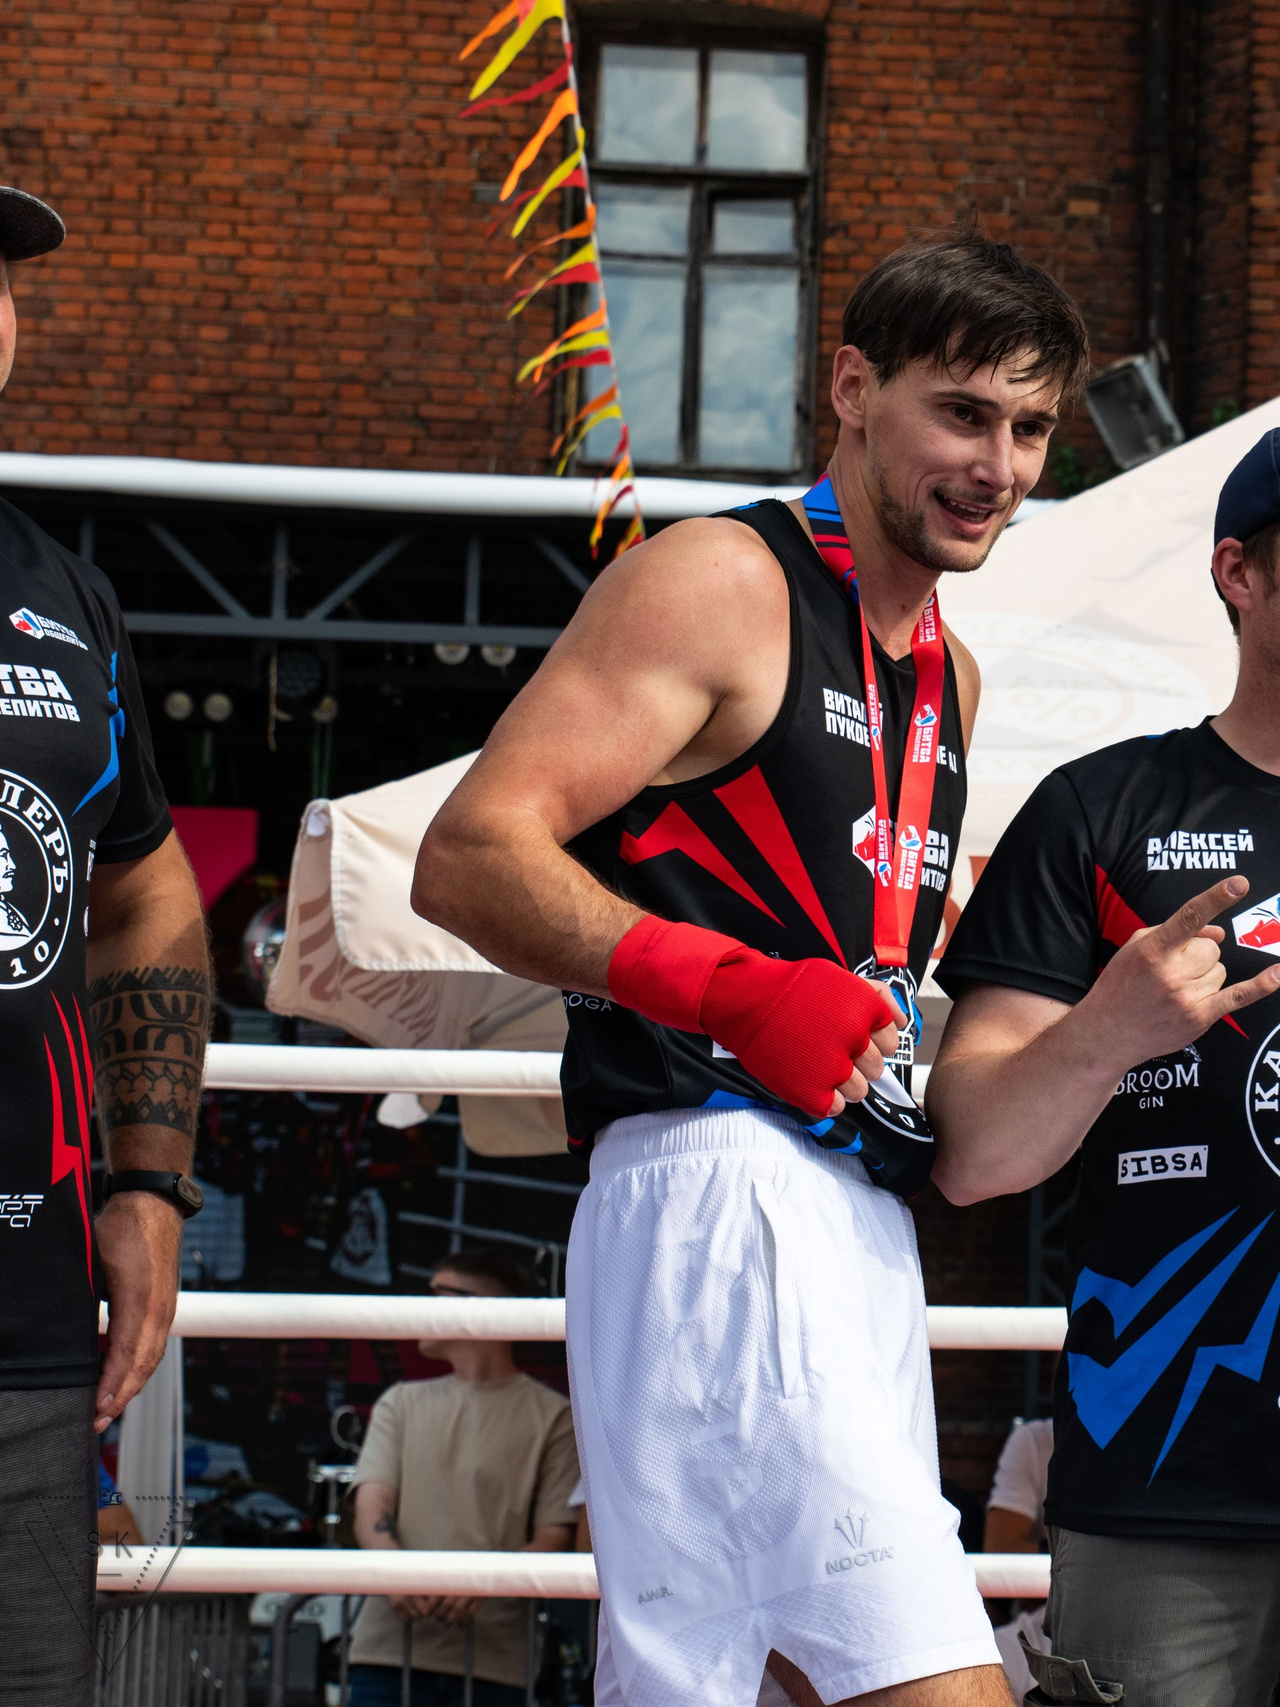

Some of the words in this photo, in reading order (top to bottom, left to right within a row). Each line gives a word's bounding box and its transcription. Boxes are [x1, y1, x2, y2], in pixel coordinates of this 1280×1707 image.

[0, 699, 80, 722] ЕПИТОВ
[1147, 829, 1255, 855] АЛЕКСЕЙ
[1147, 850, 1237, 872] ЩУКИН
[1139, 1095, 1165, 1110] GIN
[1120, 1151, 1203, 1178] SIBSA
